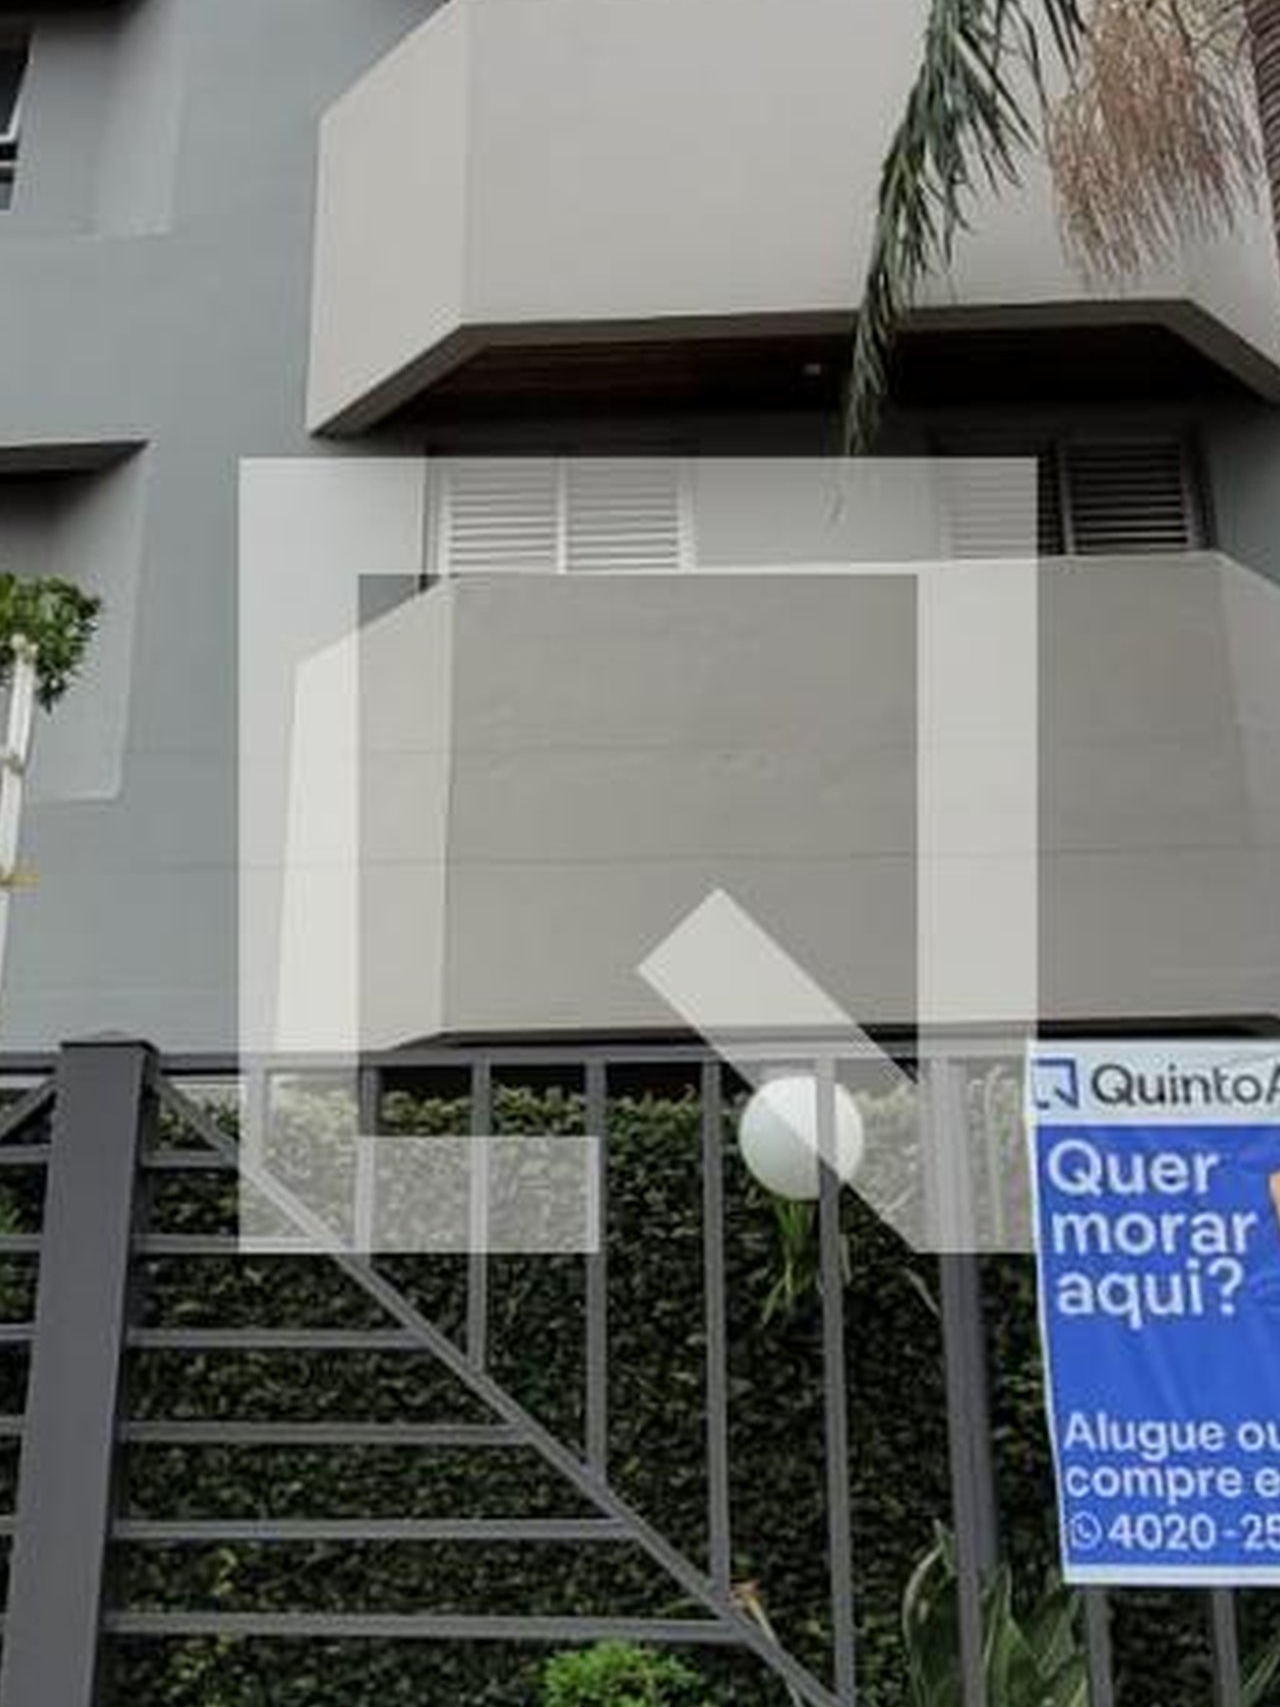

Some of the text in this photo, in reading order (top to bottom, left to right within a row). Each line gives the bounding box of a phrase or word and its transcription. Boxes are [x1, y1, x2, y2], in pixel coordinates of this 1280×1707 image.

[1047, 1139, 1220, 1197] Quer
[1051, 1209, 1259, 1255] morar
[1056, 1258, 1245, 1330] aqui?
[1062, 1411, 1226, 1462] Alugue
[1064, 1465, 1243, 1505] compre
